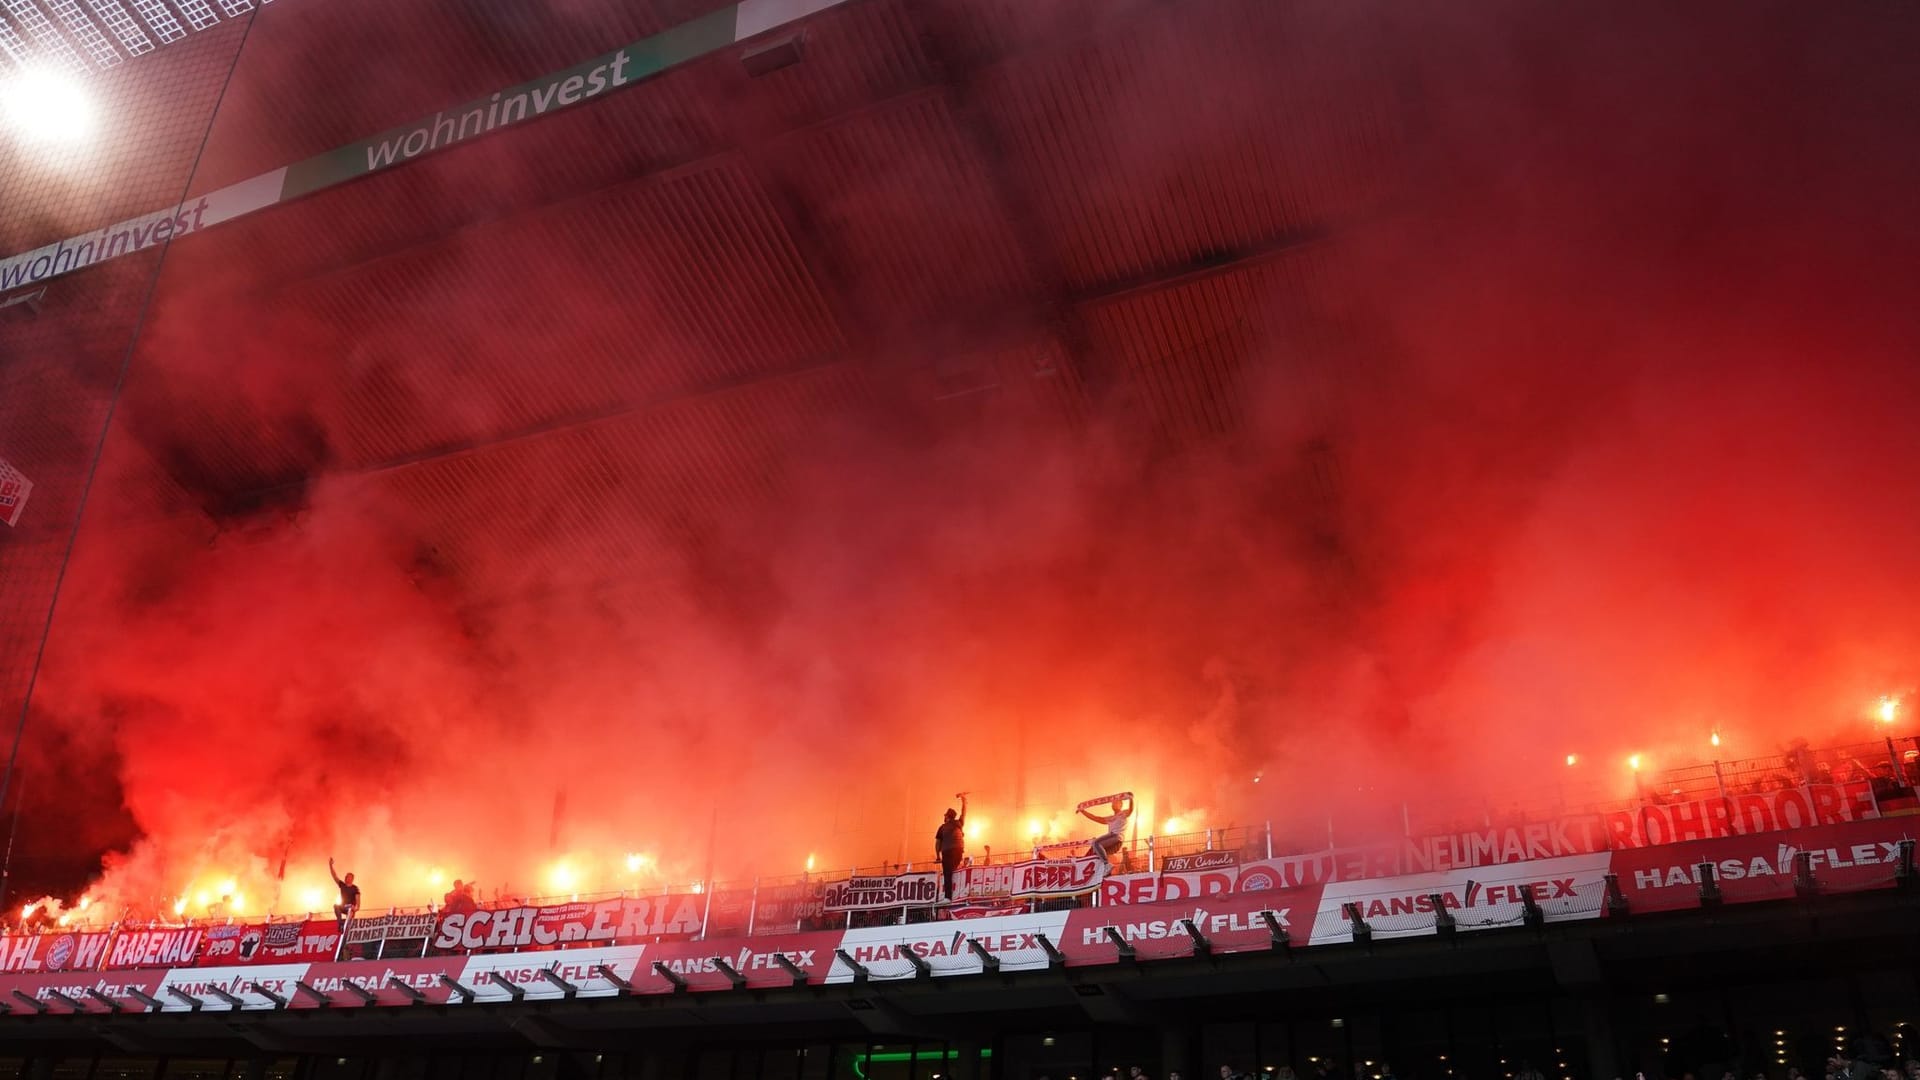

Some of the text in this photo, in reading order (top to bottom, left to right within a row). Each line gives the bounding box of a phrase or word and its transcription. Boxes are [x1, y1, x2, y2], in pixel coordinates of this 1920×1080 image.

[366, 50, 631, 171] wohninvest
[1, 197, 209, 289] wohninvest
[1606, 783, 1874, 849] ROHRDORF
[1404, 815, 1600, 872] NEUMARKT
[1022, 861, 1095, 890] REBELS
[1195, 853, 1233, 868] Casuals
[849, 879, 883, 889] Sektion
[1101, 877, 1191, 907] RED
[348, 924, 433, 942] IMMER BEI UNS
[350, 913, 435, 929] AUSGESPERRTE
[109, 930, 197, 965] RABENAU
